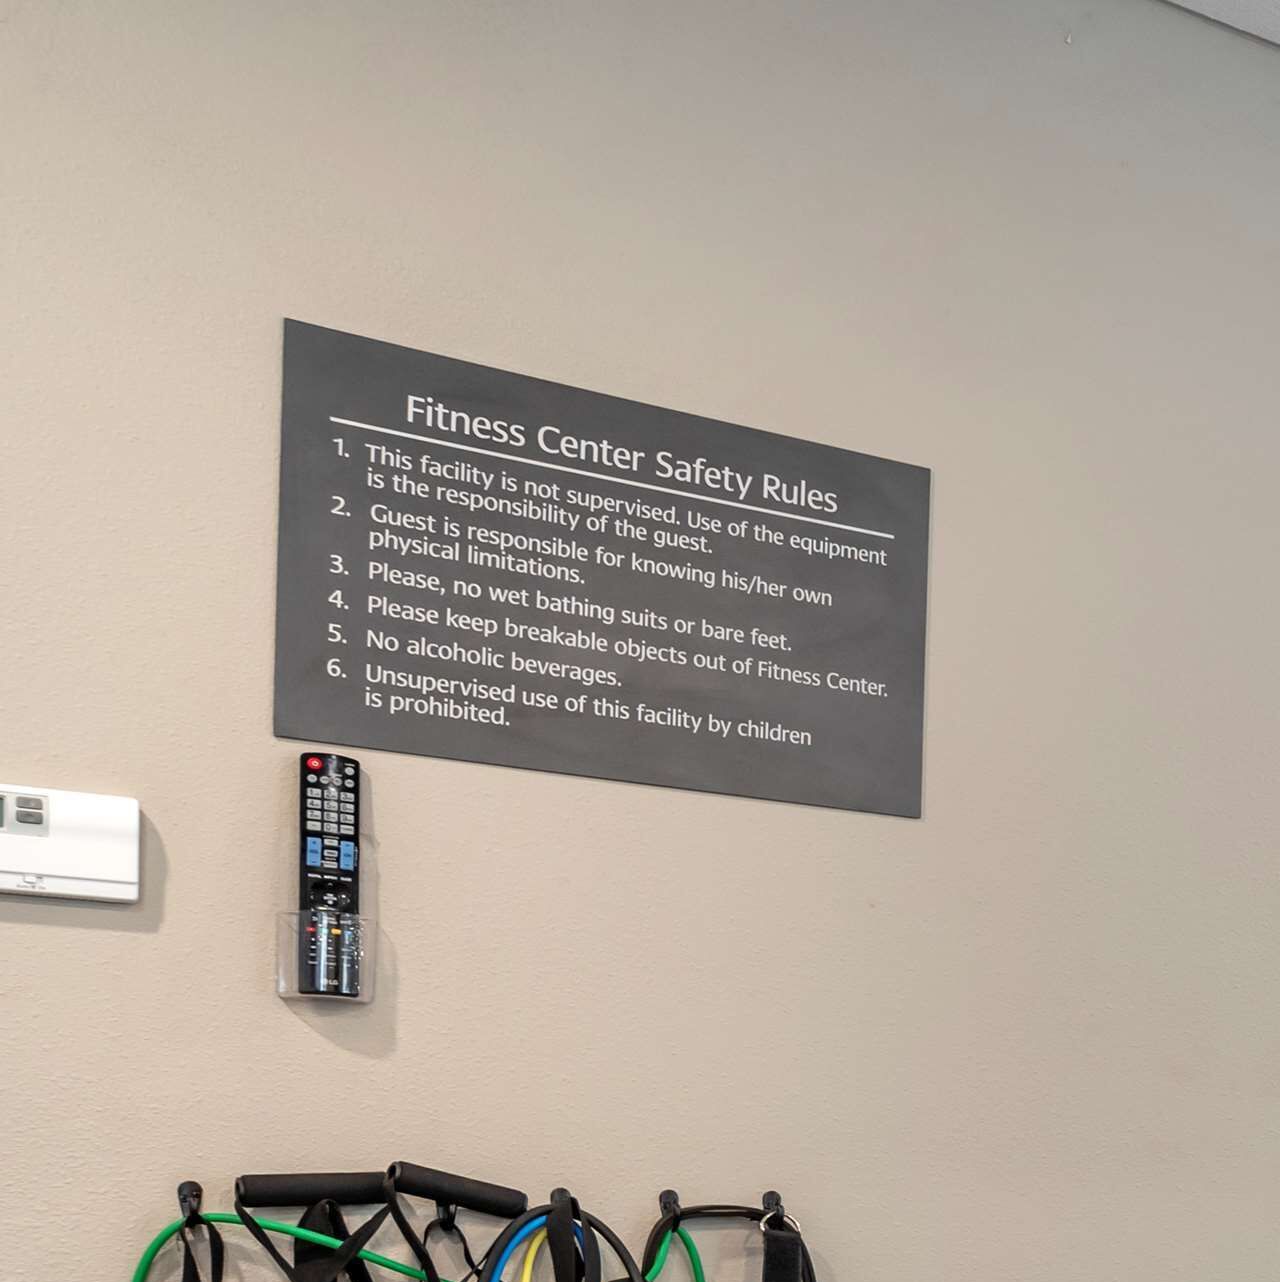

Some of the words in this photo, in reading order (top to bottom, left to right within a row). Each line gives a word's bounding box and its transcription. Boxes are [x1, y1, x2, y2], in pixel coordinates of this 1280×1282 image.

[406, 394, 525, 446] Fitness
[537, 425, 645, 471] Center
[655, 451, 752, 500] Safety
[762, 473, 837, 512] Rules
[332, 437, 349, 457] 1.
[364, 443, 412, 470] This
[419, 454, 494, 490] facility
[501, 470, 517, 491] is
[524, 480, 560, 501] not
[566, 489, 680, 525] supervised.
[687, 510, 721, 533] Use
[727, 520, 748, 537] of
[753, 524, 784, 545] the
[789, 534, 887, 566] equipment
[367, 466, 384, 488] is
[391, 473, 429, 497] the
[436, 486, 580, 531] responsibility
[586, 514, 609, 532] of
[614, 518, 647, 540] the
[653, 530, 712, 553] guest.
[330, 495, 351, 516] 2.
[370, 503, 436, 533] Guest
[443, 515, 460, 537] is
[467, 525, 588, 561] responsible
[594, 545, 625, 567] for
[631, 551, 715, 588] knowing
[721, 568, 787, 597] his/her
[792, 587, 832, 606] own
[369, 528, 459, 561] physical
[467, 544, 584, 584] limitations.
[327, 589, 349, 609] 4.
[367, 595, 439, 624] Please
[446, 607, 498, 637] keep
[504, 617, 608, 652] breakable
[613, 637, 687, 664] objects
[693, 653, 726, 671] out
[731, 657, 753, 675] of
[757, 660, 820, 686] Fitness
[826, 672, 887, 697] Center.
[329, 553, 349, 575] 3.
[368, 561, 445, 595] Please,
[453, 579, 481, 598] no
[488, 585, 529, 607] wet
[536, 589, 614, 624] bathing
[620, 608, 667, 630] suits
[673, 618, 695, 634] or
[701, 618, 744, 643] bare
[749, 627, 791, 651] feet.
[327, 622, 347, 643] 5.
[366, 629, 399, 651] No
[406, 636, 504, 668] alcoholic
[511, 651, 621, 686] beverages.
[326, 657, 346, 678] 6.
[365, 663, 515, 703] Unsupervised
[522, 690, 558, 709] use
[564, 694, 588, 712] of
[592, 697, 629, 719] this
[635, 703, 702, 733] facility
[708, 713, 731, 737] by
[737, 719, 811, 745] children
[365, 686, 382, 707] is
[389, 695, 510, 726] prohibited.
